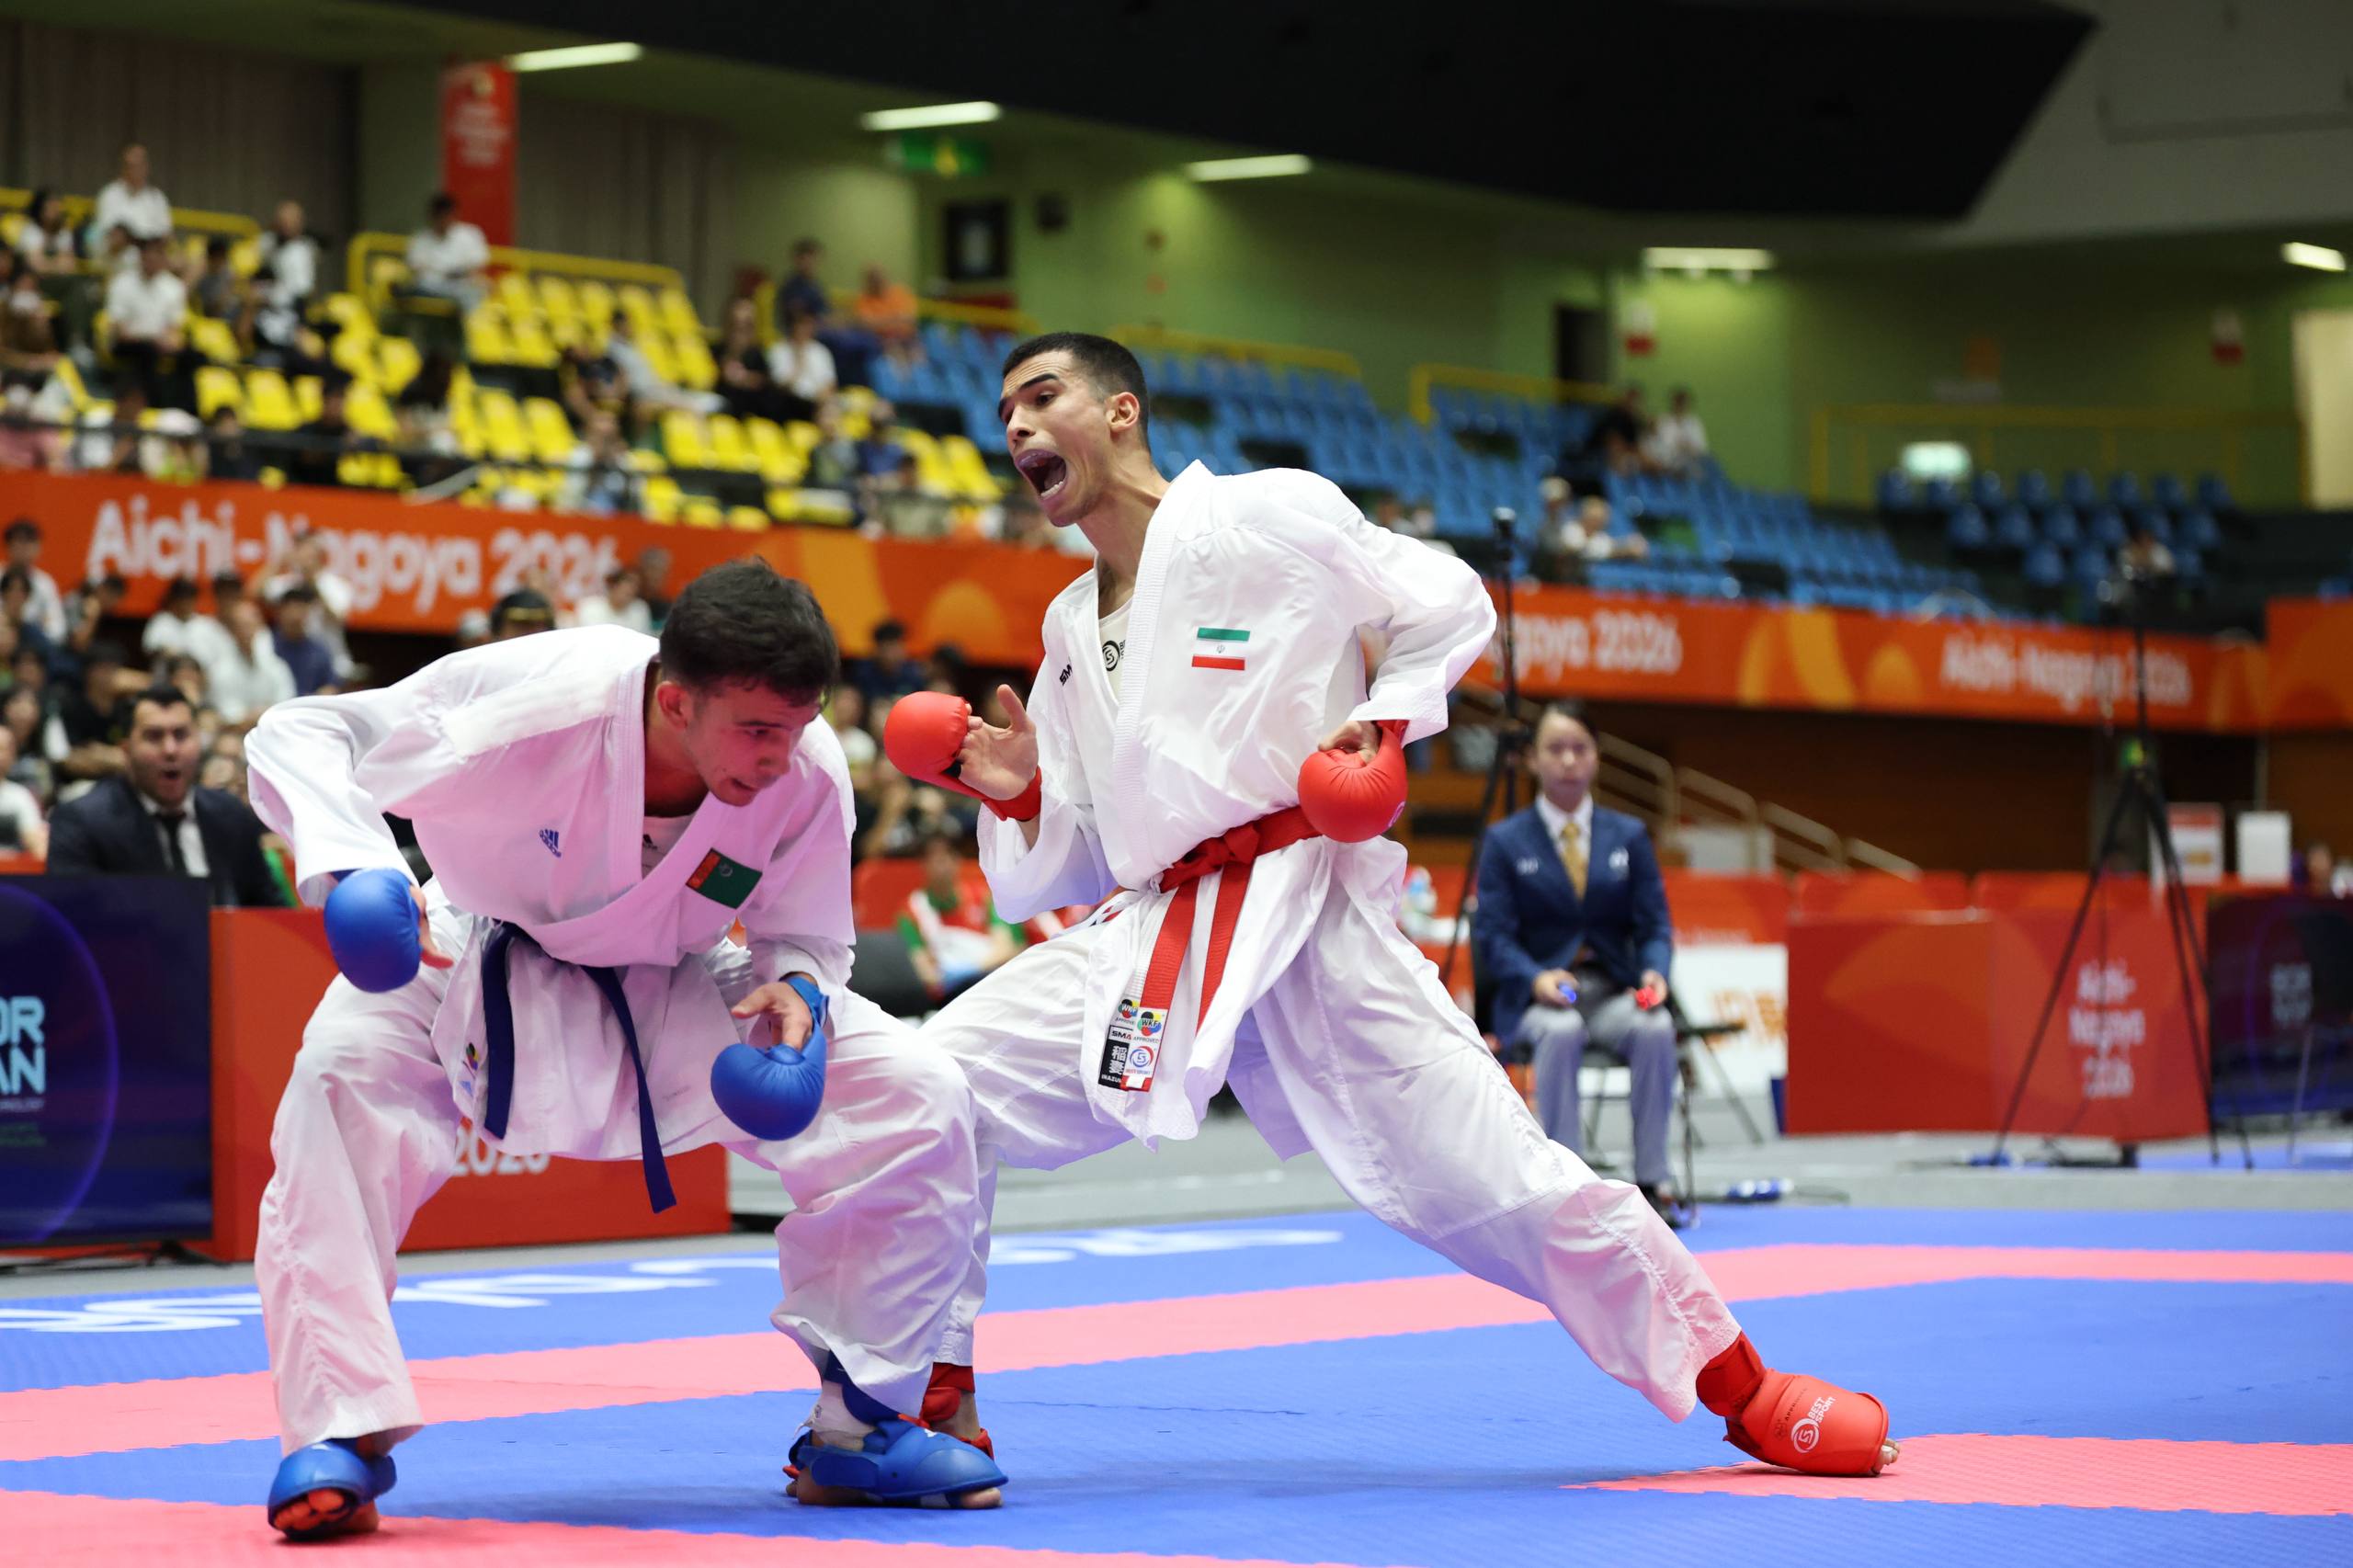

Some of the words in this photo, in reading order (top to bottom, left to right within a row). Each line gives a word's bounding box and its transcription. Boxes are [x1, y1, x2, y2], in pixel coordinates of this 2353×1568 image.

[0, 995, 45, 1046] R
[1142, 1018, 1159, 1028] WKF
[0, 1045, 45, 1095] N
[1807, 1397, 1824, 1419] BEST
[1815, 1396, 1836, 1423] SPORT
